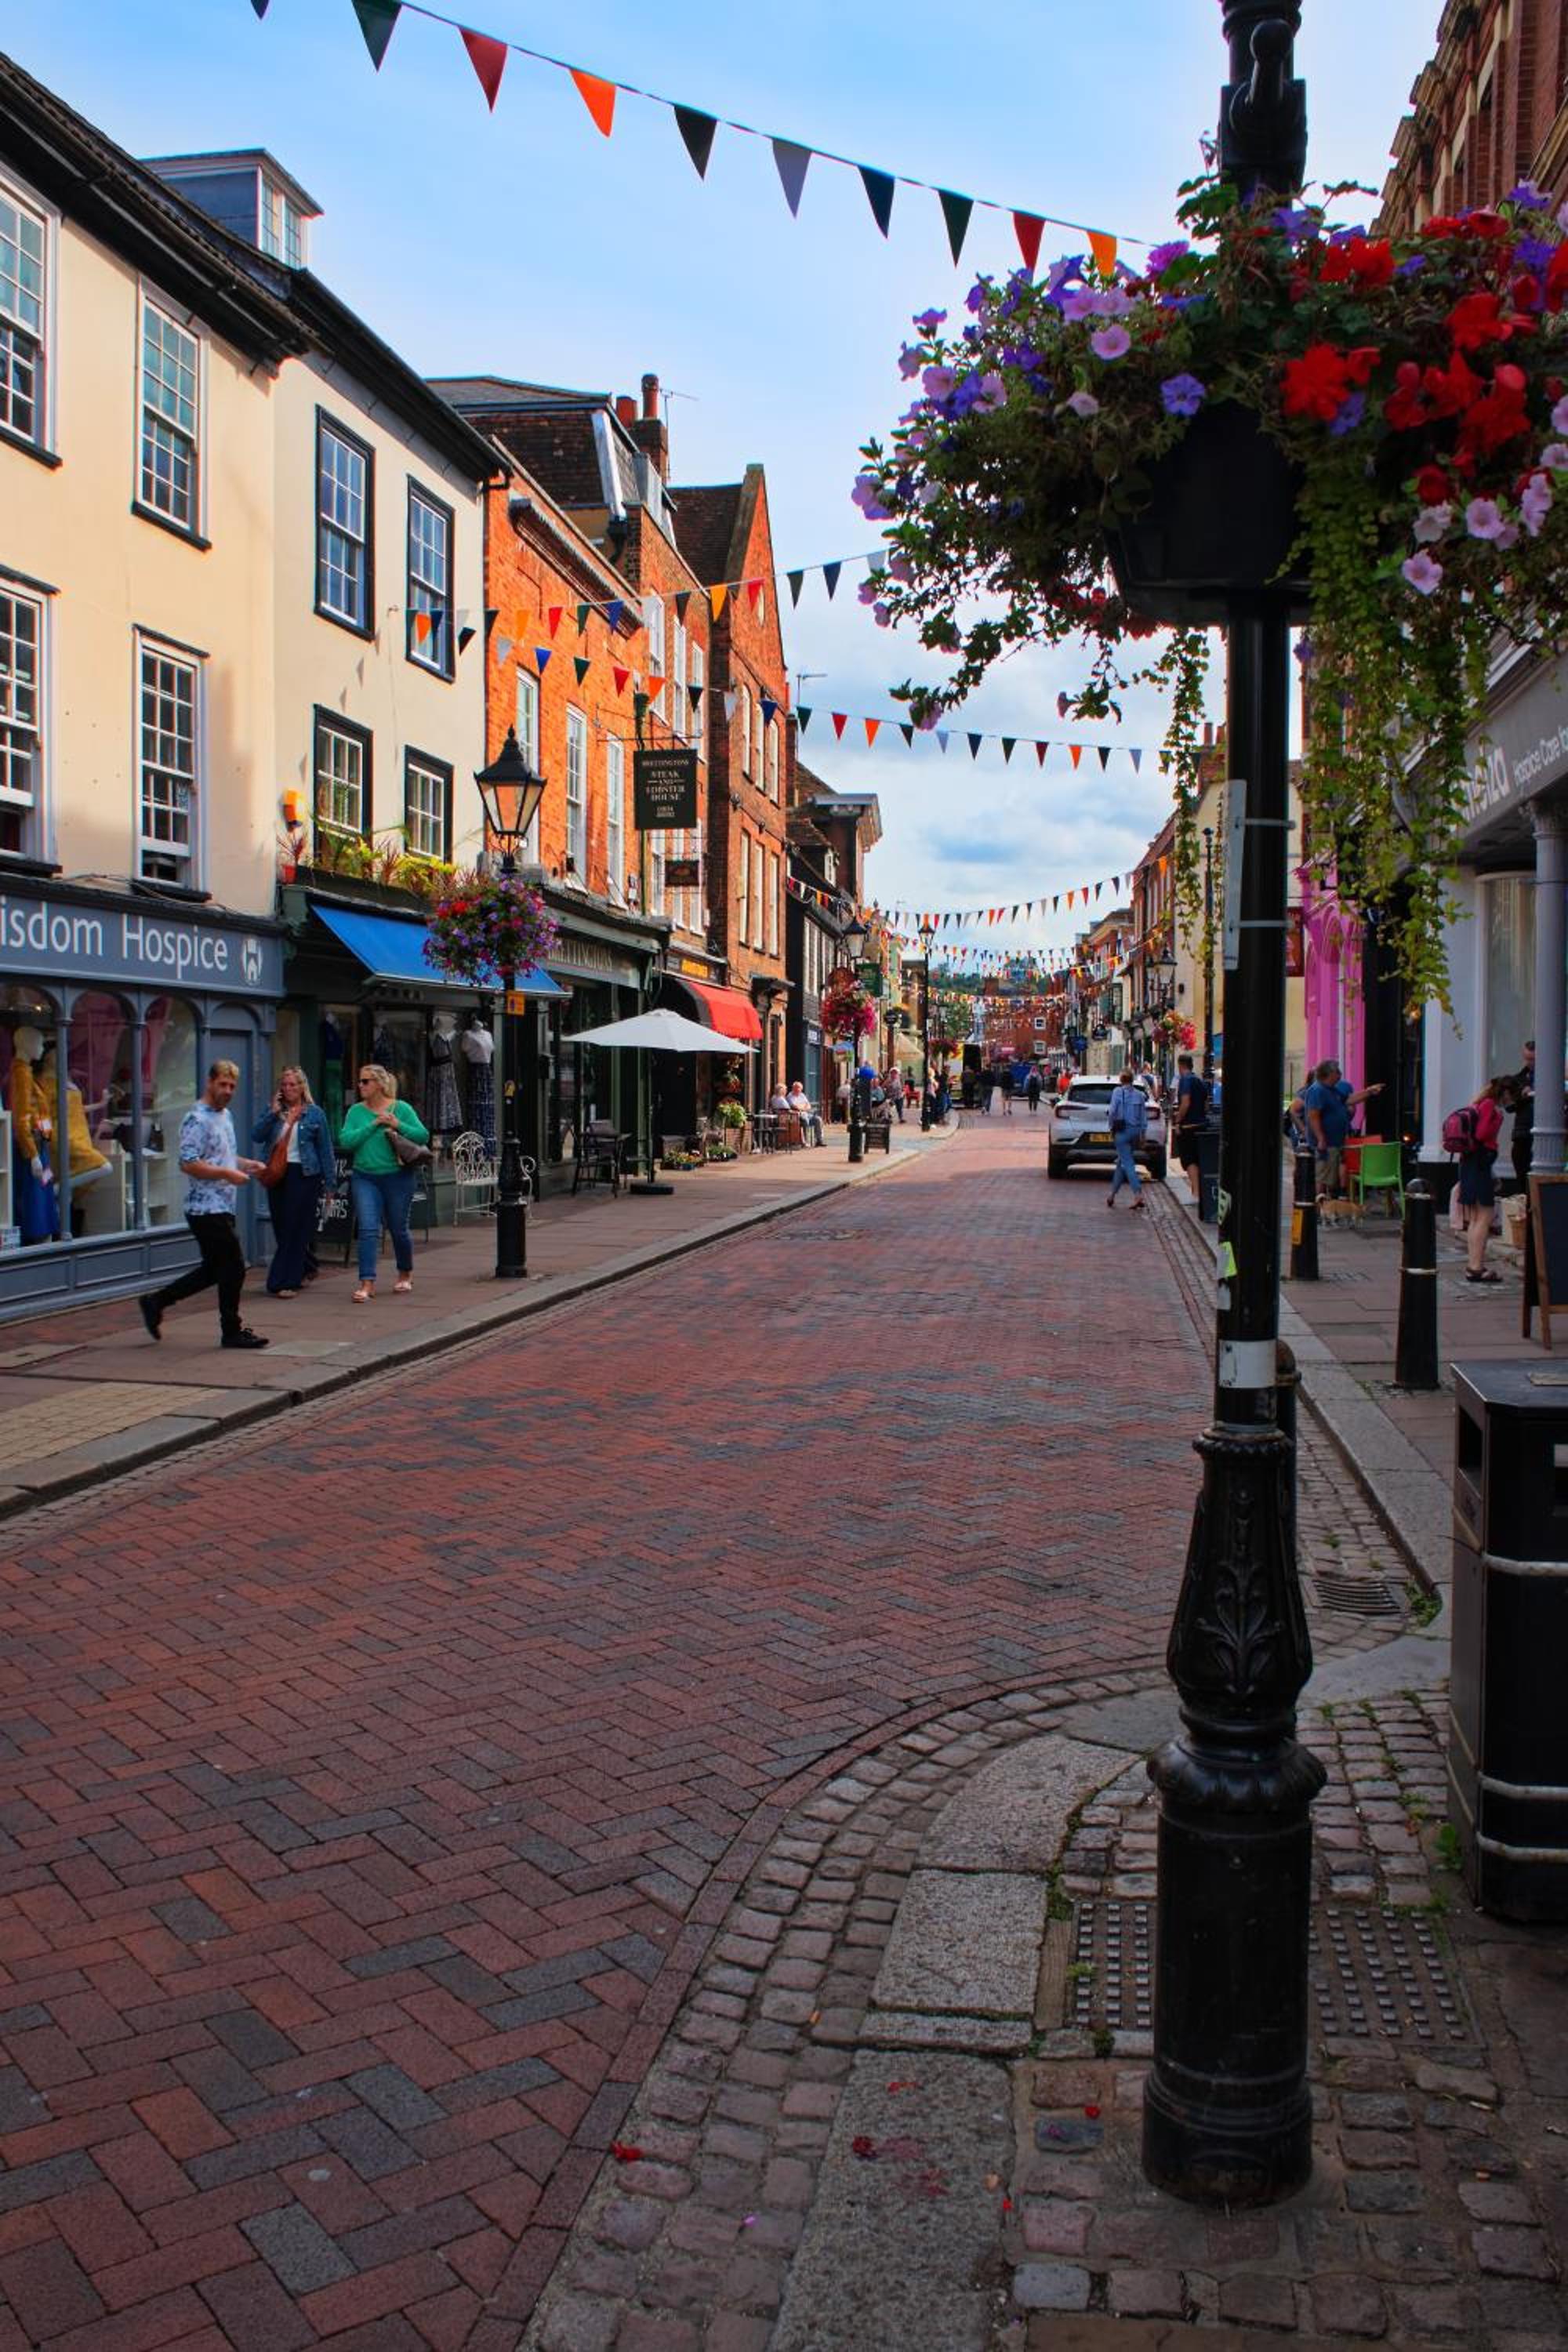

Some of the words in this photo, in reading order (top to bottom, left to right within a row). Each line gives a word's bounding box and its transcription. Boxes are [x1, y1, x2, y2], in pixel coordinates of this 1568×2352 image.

[645, 785, 686, 794] LOBSTER
[1513, 750, 1541, 796] Hospice
[1540, 737, 1561, 766] Care
[0, 895, 103, 956] isdom
[122, 913, 228, 980] Hospice
